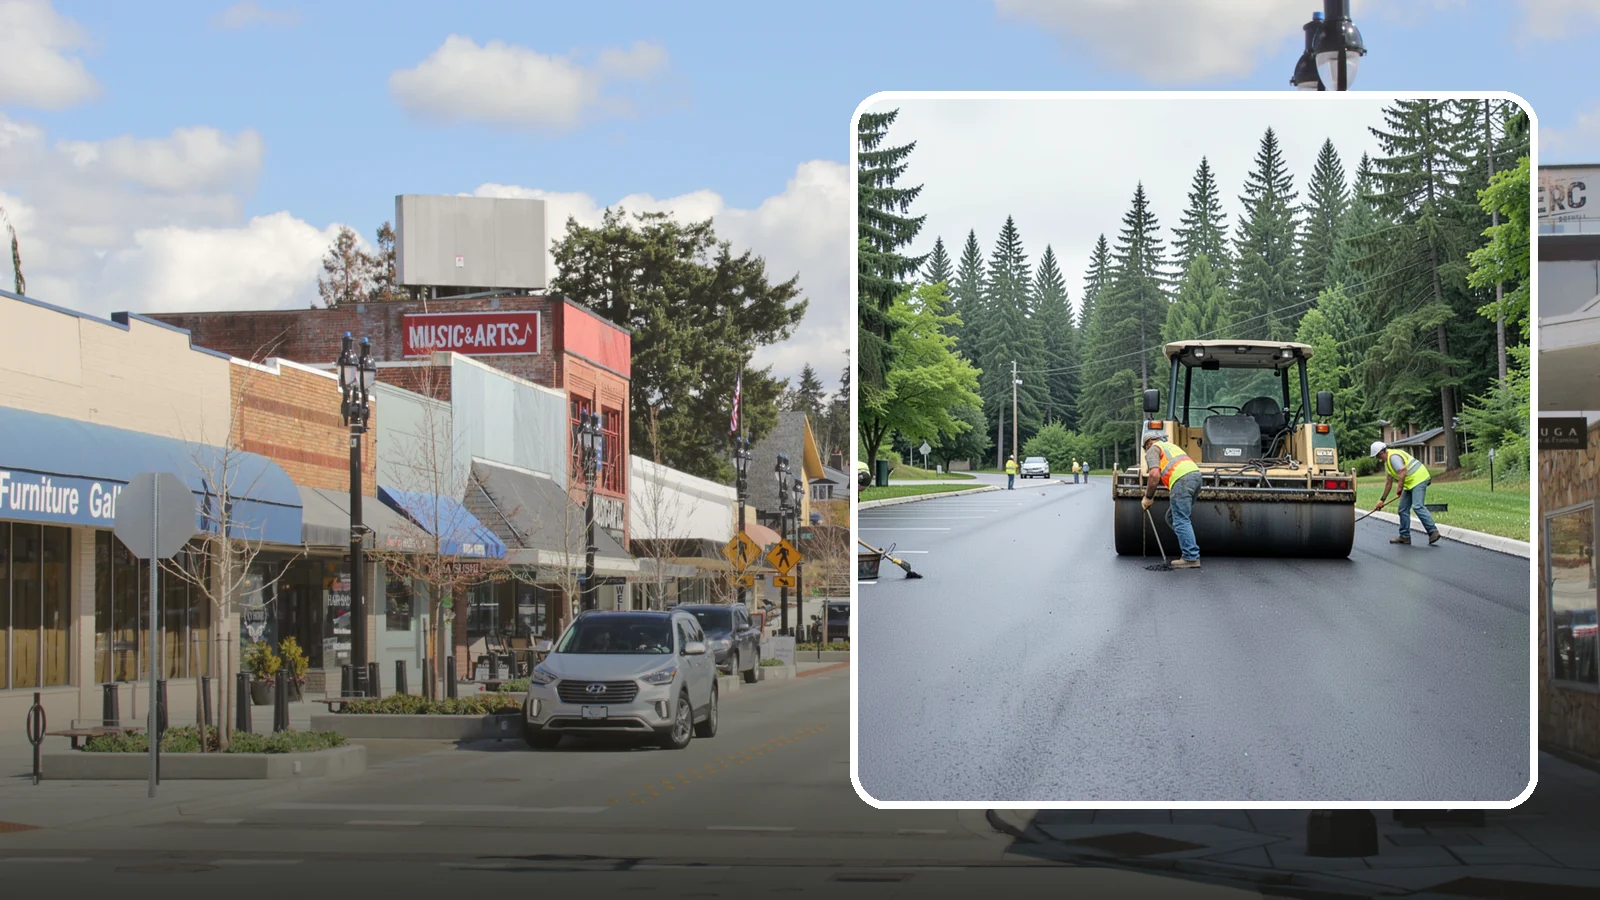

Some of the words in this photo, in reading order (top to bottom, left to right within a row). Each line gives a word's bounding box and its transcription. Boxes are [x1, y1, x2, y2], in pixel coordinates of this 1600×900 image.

[1552, 436, 1579, 444] Framing
[0, 471, 79, 515] Furniture
[89, 482, 122, 519] Gal
